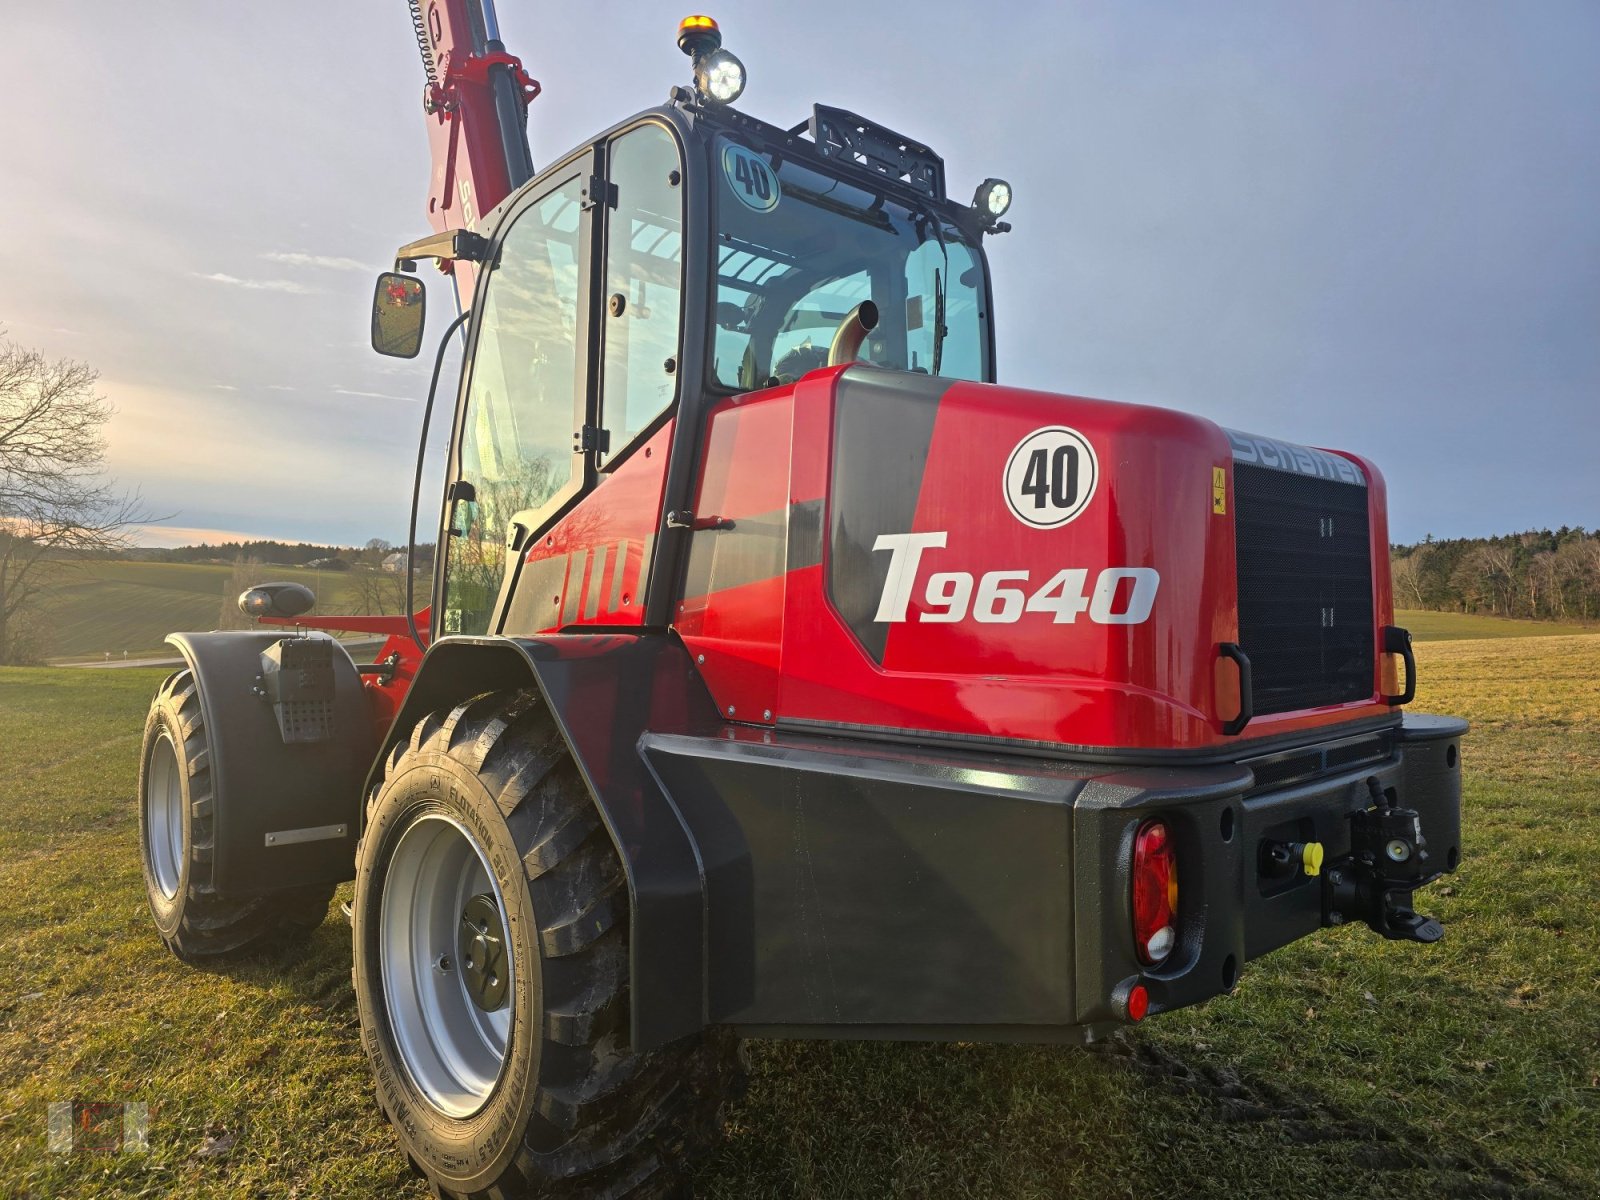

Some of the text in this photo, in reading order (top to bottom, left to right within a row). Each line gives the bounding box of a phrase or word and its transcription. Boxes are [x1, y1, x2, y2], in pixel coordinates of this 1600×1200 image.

[734, 153, 770, 201] 40
[1021, 444, 1080, 510] 40
[872, 530, 1160, 625] T9640
[449, 786, 494, 852] FLOTATION
[367, 1026, 411, 1123] ALLIANCE
